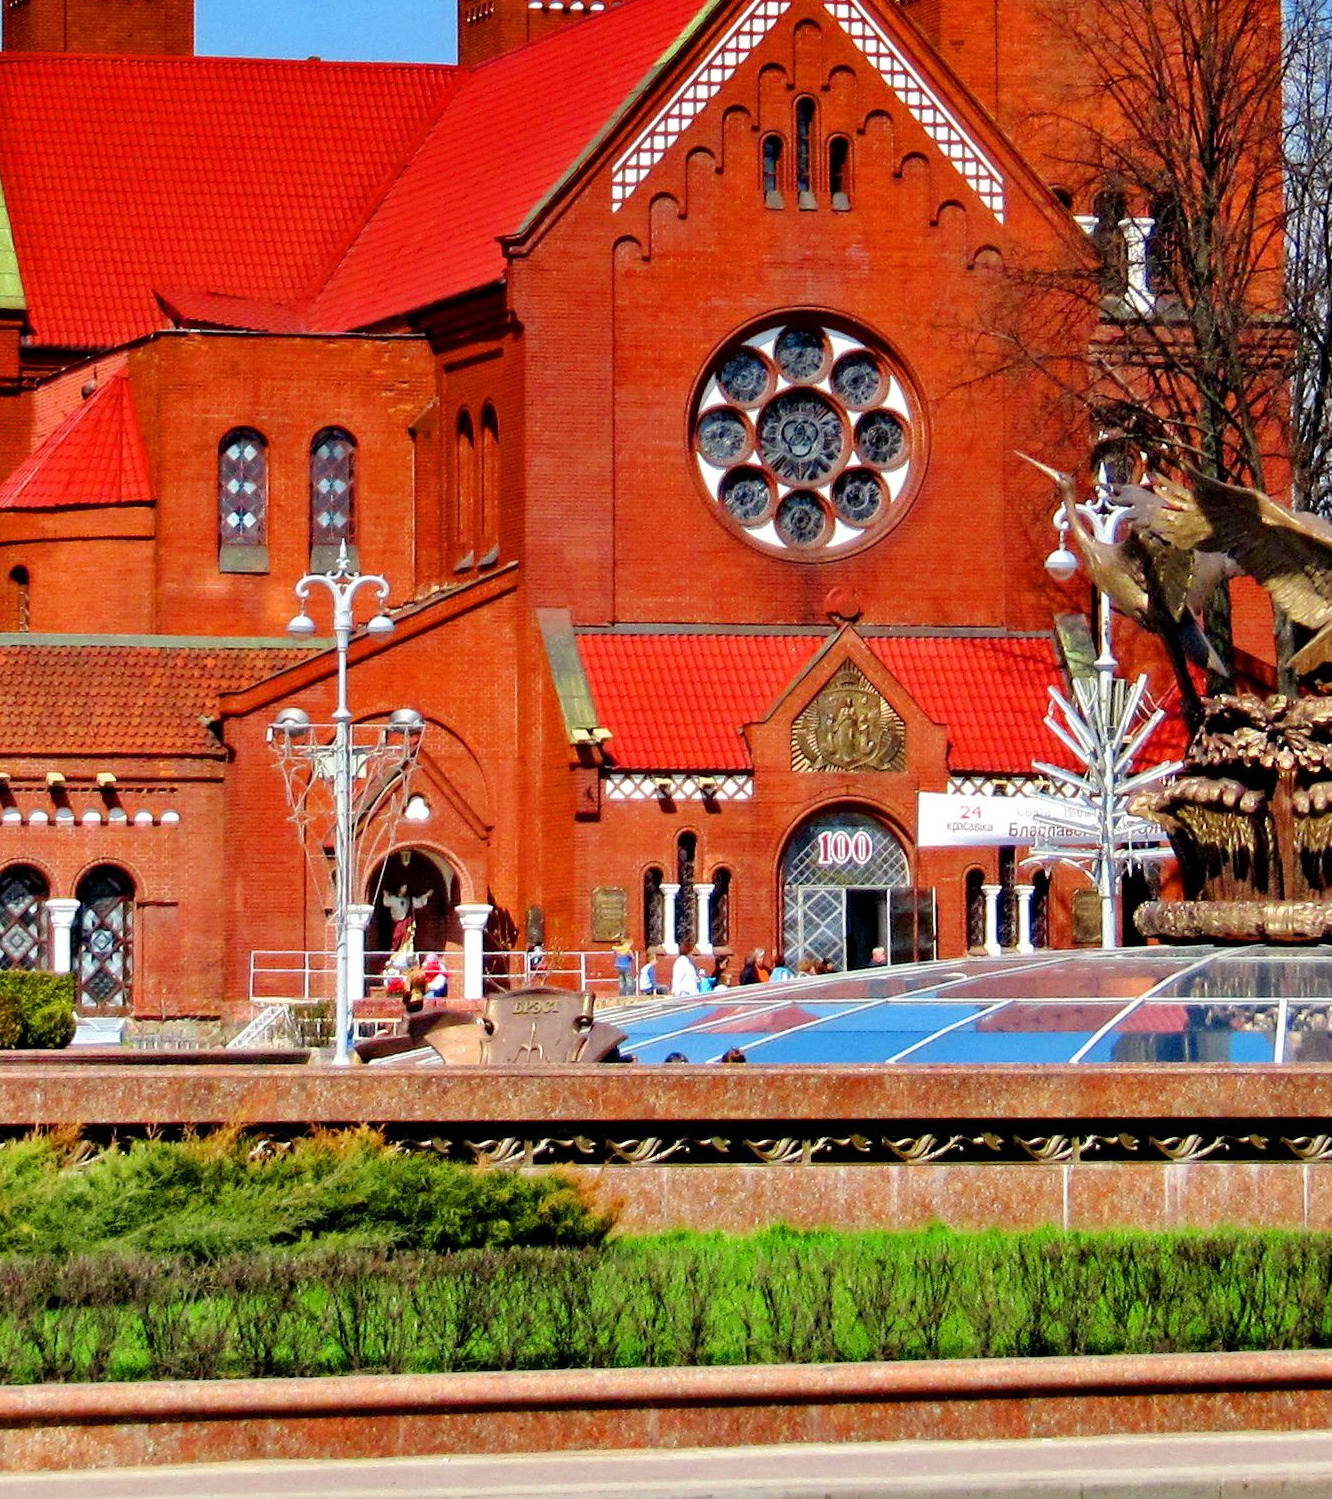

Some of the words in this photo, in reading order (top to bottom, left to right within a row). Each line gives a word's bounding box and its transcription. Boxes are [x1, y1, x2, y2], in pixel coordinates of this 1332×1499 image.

[959, 804, 982, 820] 24
[946, 821, 994, 833] красавіка
[818, 830, 873, 865] 100
